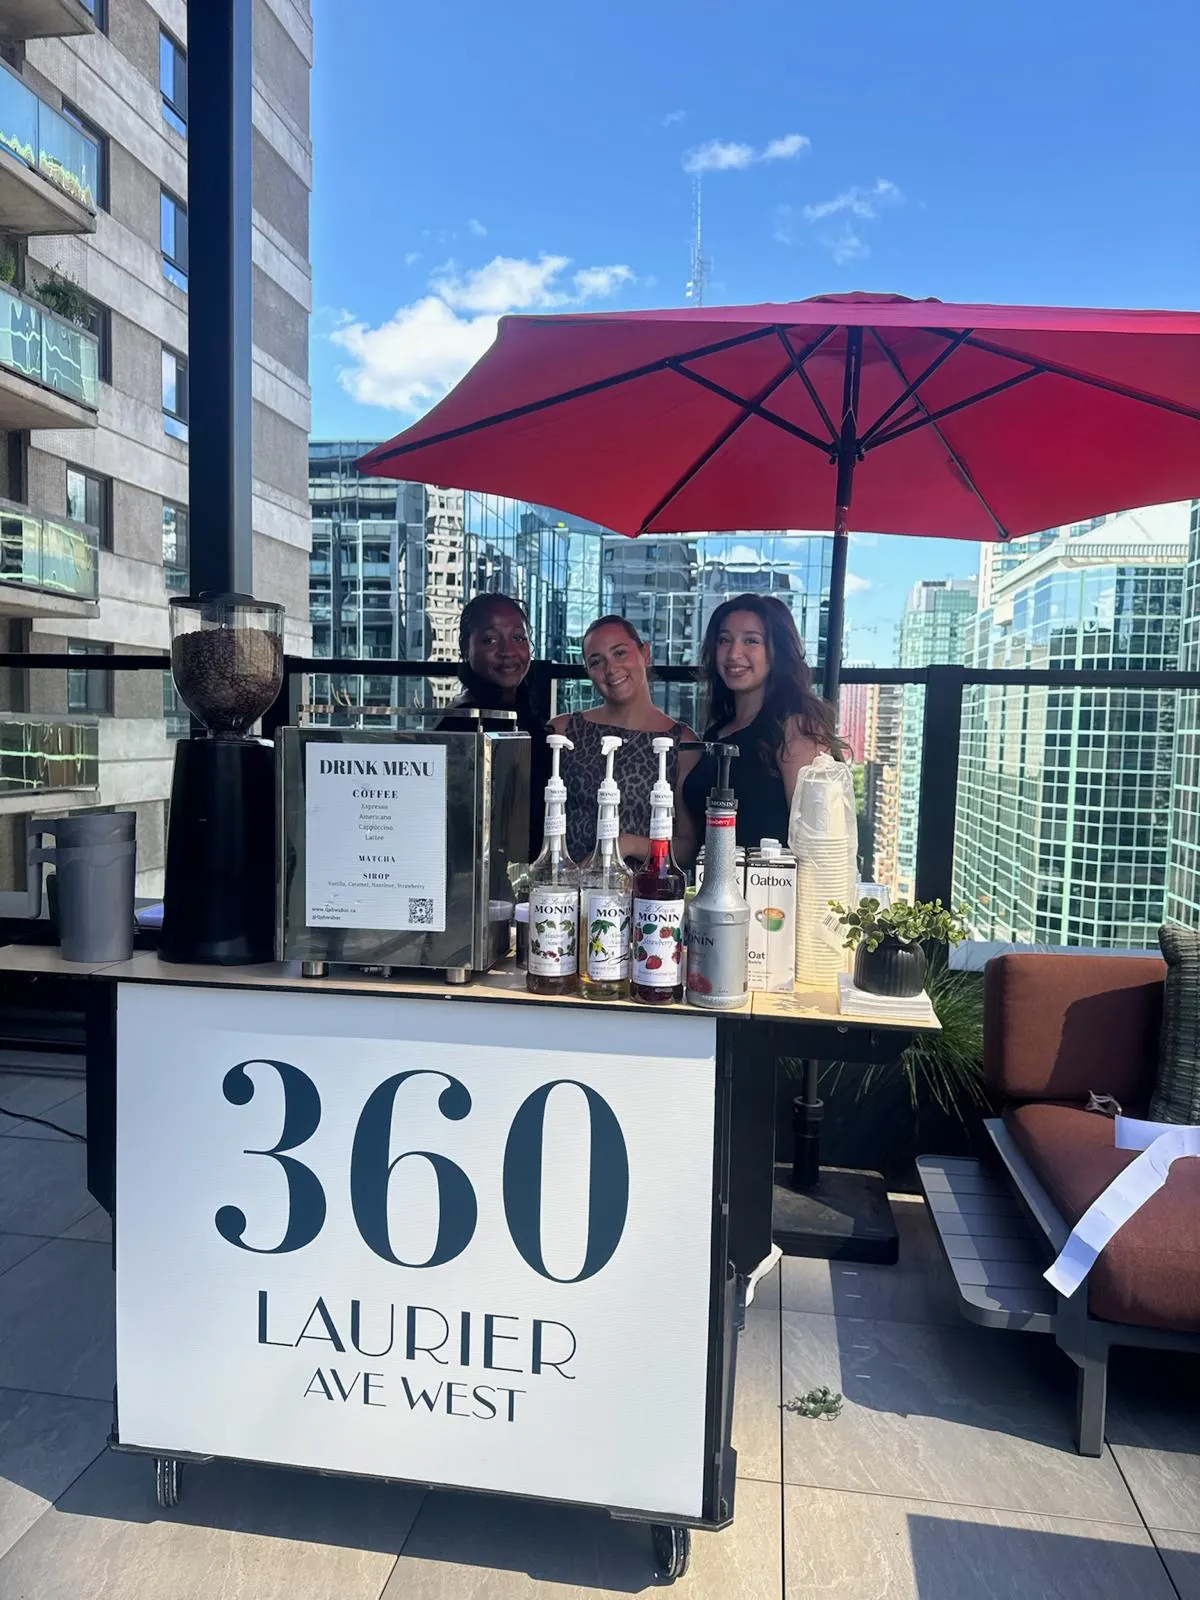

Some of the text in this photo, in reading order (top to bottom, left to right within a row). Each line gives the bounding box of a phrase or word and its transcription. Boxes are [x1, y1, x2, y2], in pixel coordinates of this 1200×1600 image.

[320, 759, 435, 777] DRINK MENU
[352, 789, 399, 799] COFFEE
[359, 812, 391, 820] Americano
[358, 855, 396, 863] MATCHA
[750, 873, 792, 887] Oatbox
[535, 904, 575, 915] MONIN
[639, 911, 680, 923] MONIN
[688, 933, 714, 947] ONIN
[748, 951, 765, 960] Oat
[214, 1058, 630, 1285] 360
[257, 1289, 578, 1381] LAURIER
[303, 1366, 527, 1423] AVE WEST
